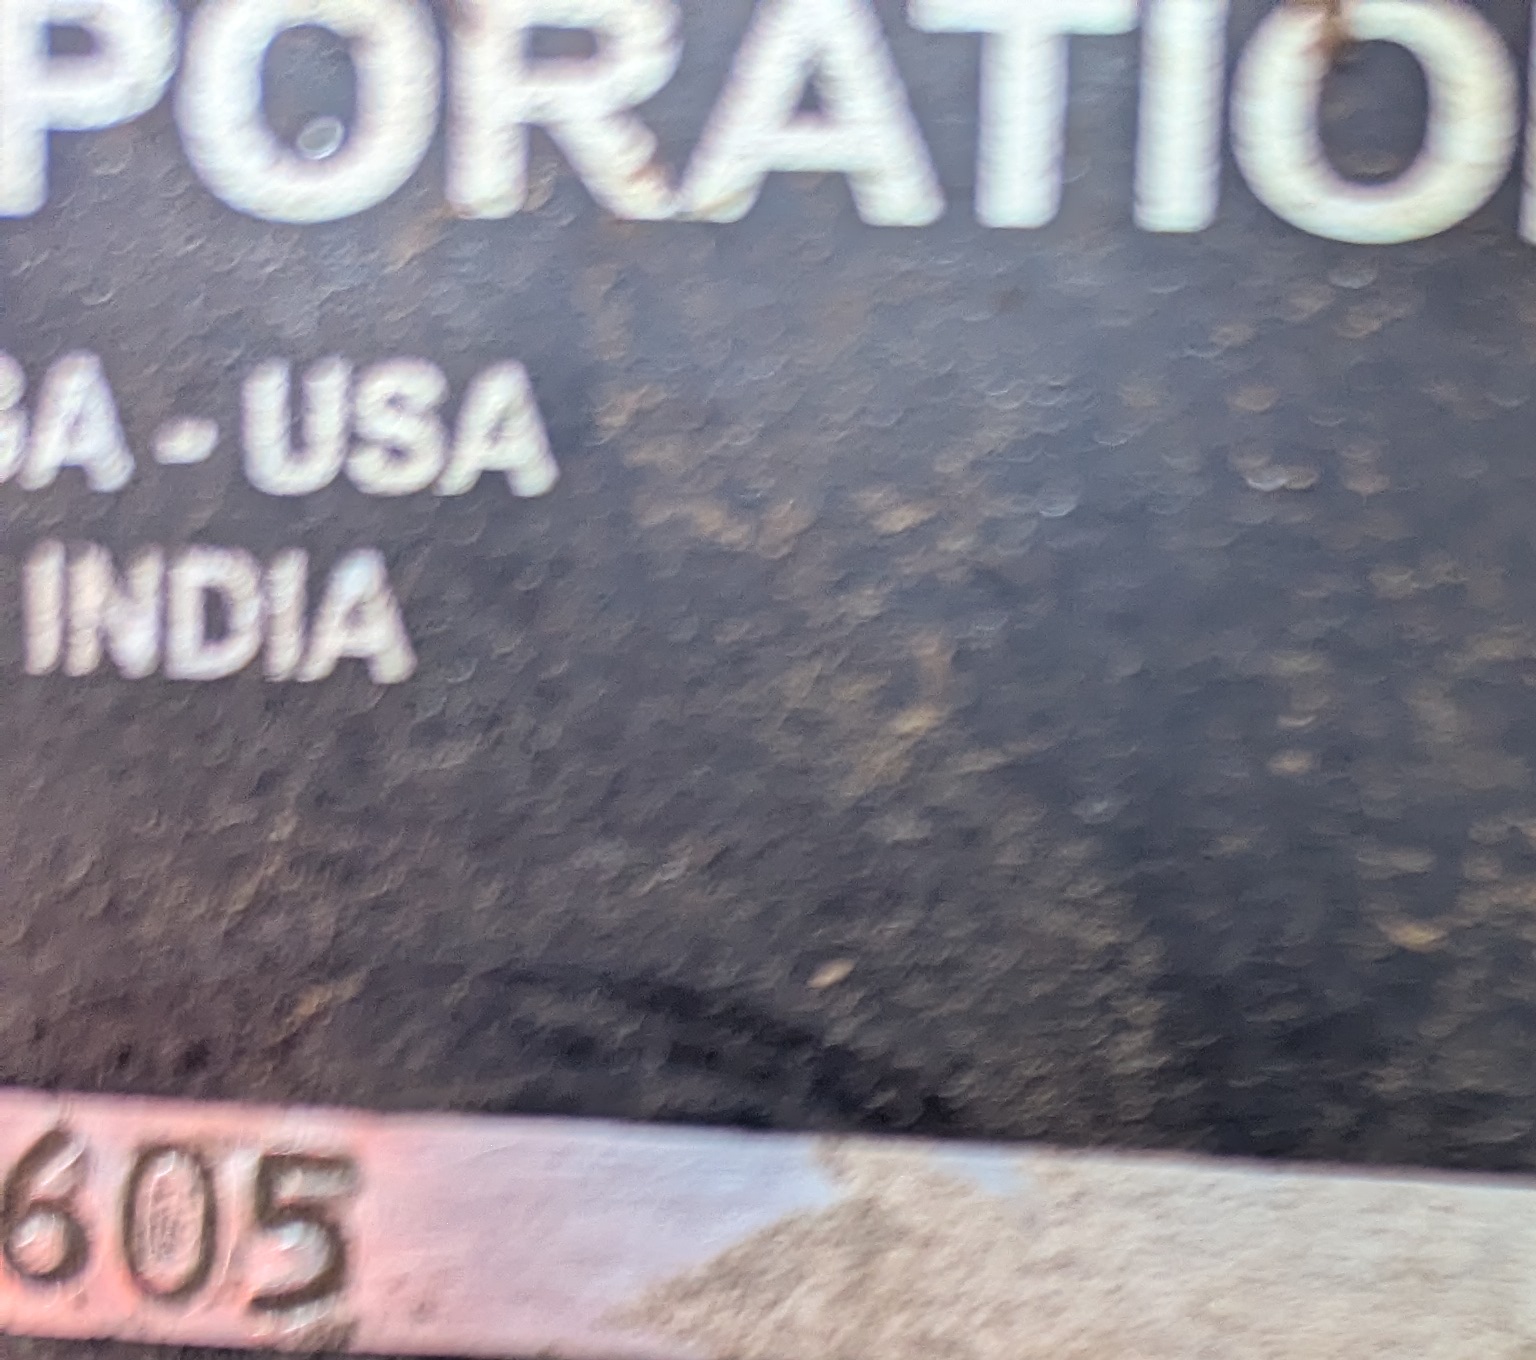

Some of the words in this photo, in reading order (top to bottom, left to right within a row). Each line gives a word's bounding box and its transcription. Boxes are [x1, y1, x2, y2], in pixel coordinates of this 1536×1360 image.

[241, 358, 560, 497] USA
[22, 538, 417, 684] INDIA
[1, 1128, 358, 1317] 605
